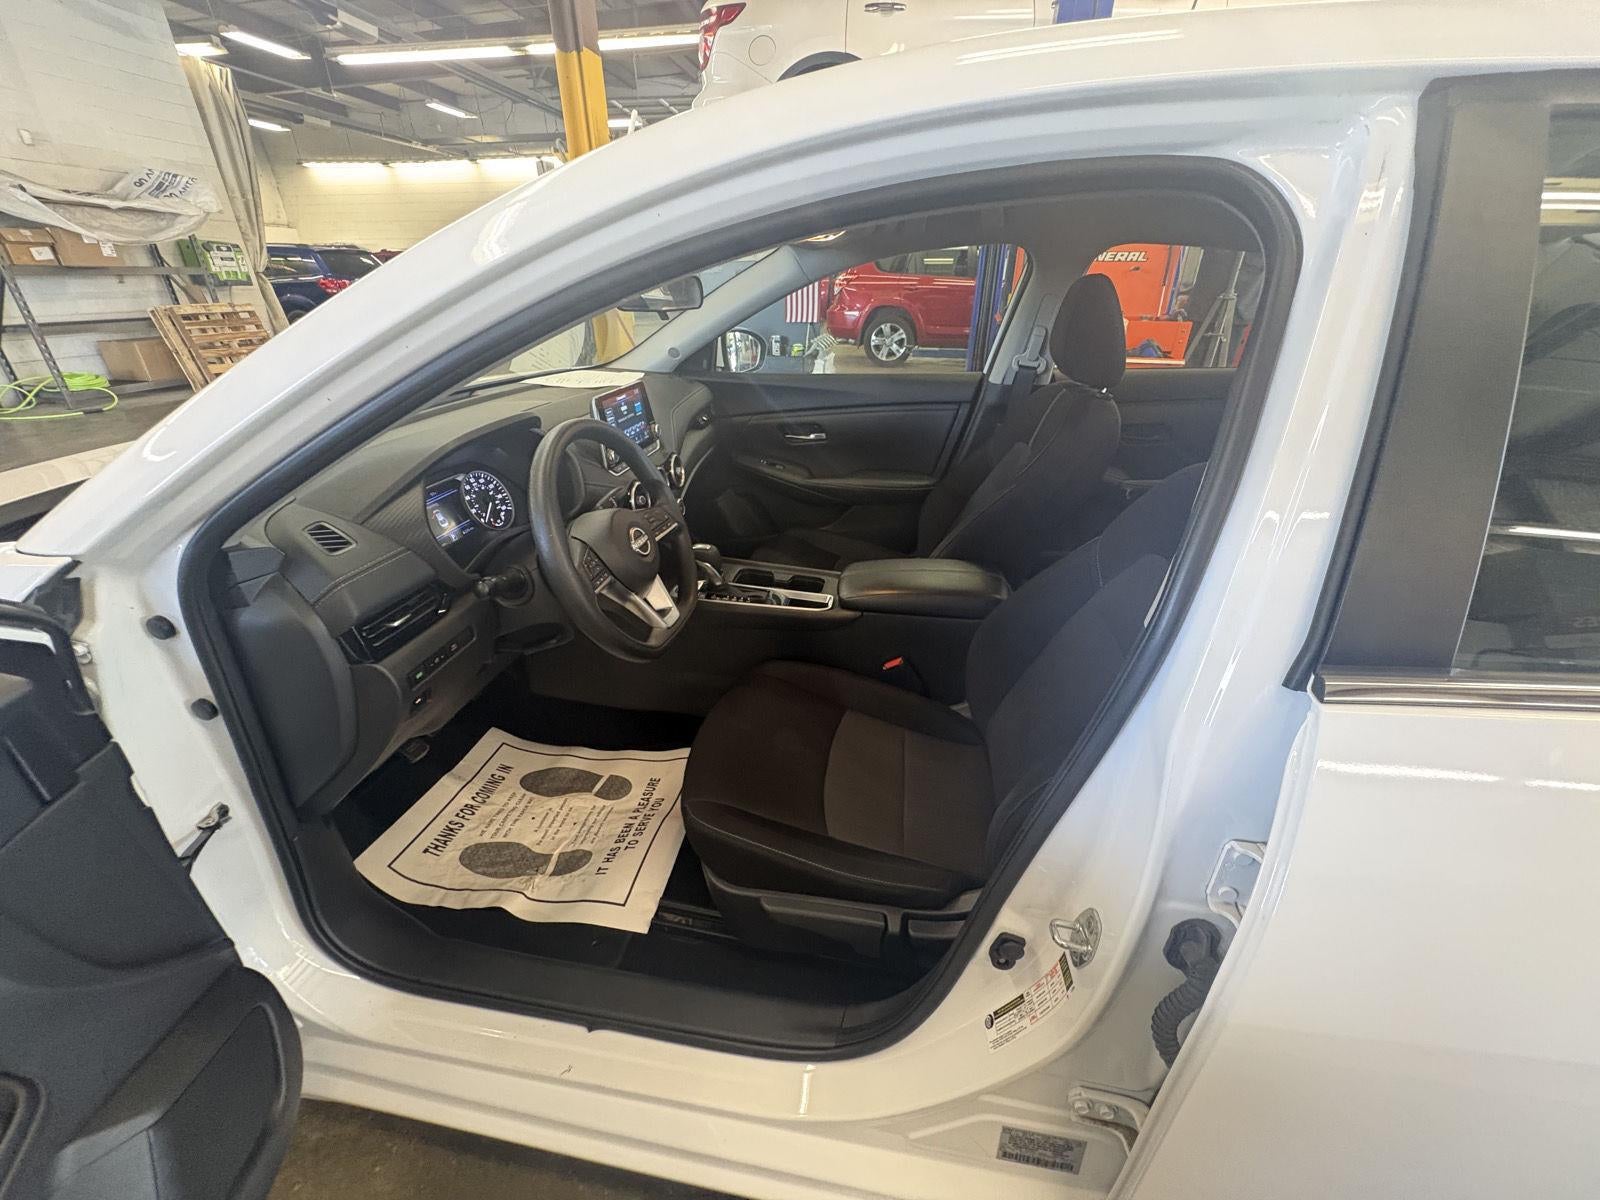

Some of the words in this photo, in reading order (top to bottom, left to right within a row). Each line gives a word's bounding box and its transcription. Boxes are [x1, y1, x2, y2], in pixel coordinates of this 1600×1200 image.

[632, 777, 661, 813] PLEASURE
[422, 820, 465, 857] THANKS
[455, 803, 481, 821] FOR
[471, 773, 506, 804] COMING
[496, 763, 515, 774] IN
[624, 839, 639, 851] TO
[633, 812, 655, 837] SERVE
[649, 797, 665, 813] YOU
[614, 822, 636, 844] BEEN
[601, 846, 621, 863] HAS
[595, 866, 609, 876] IT
